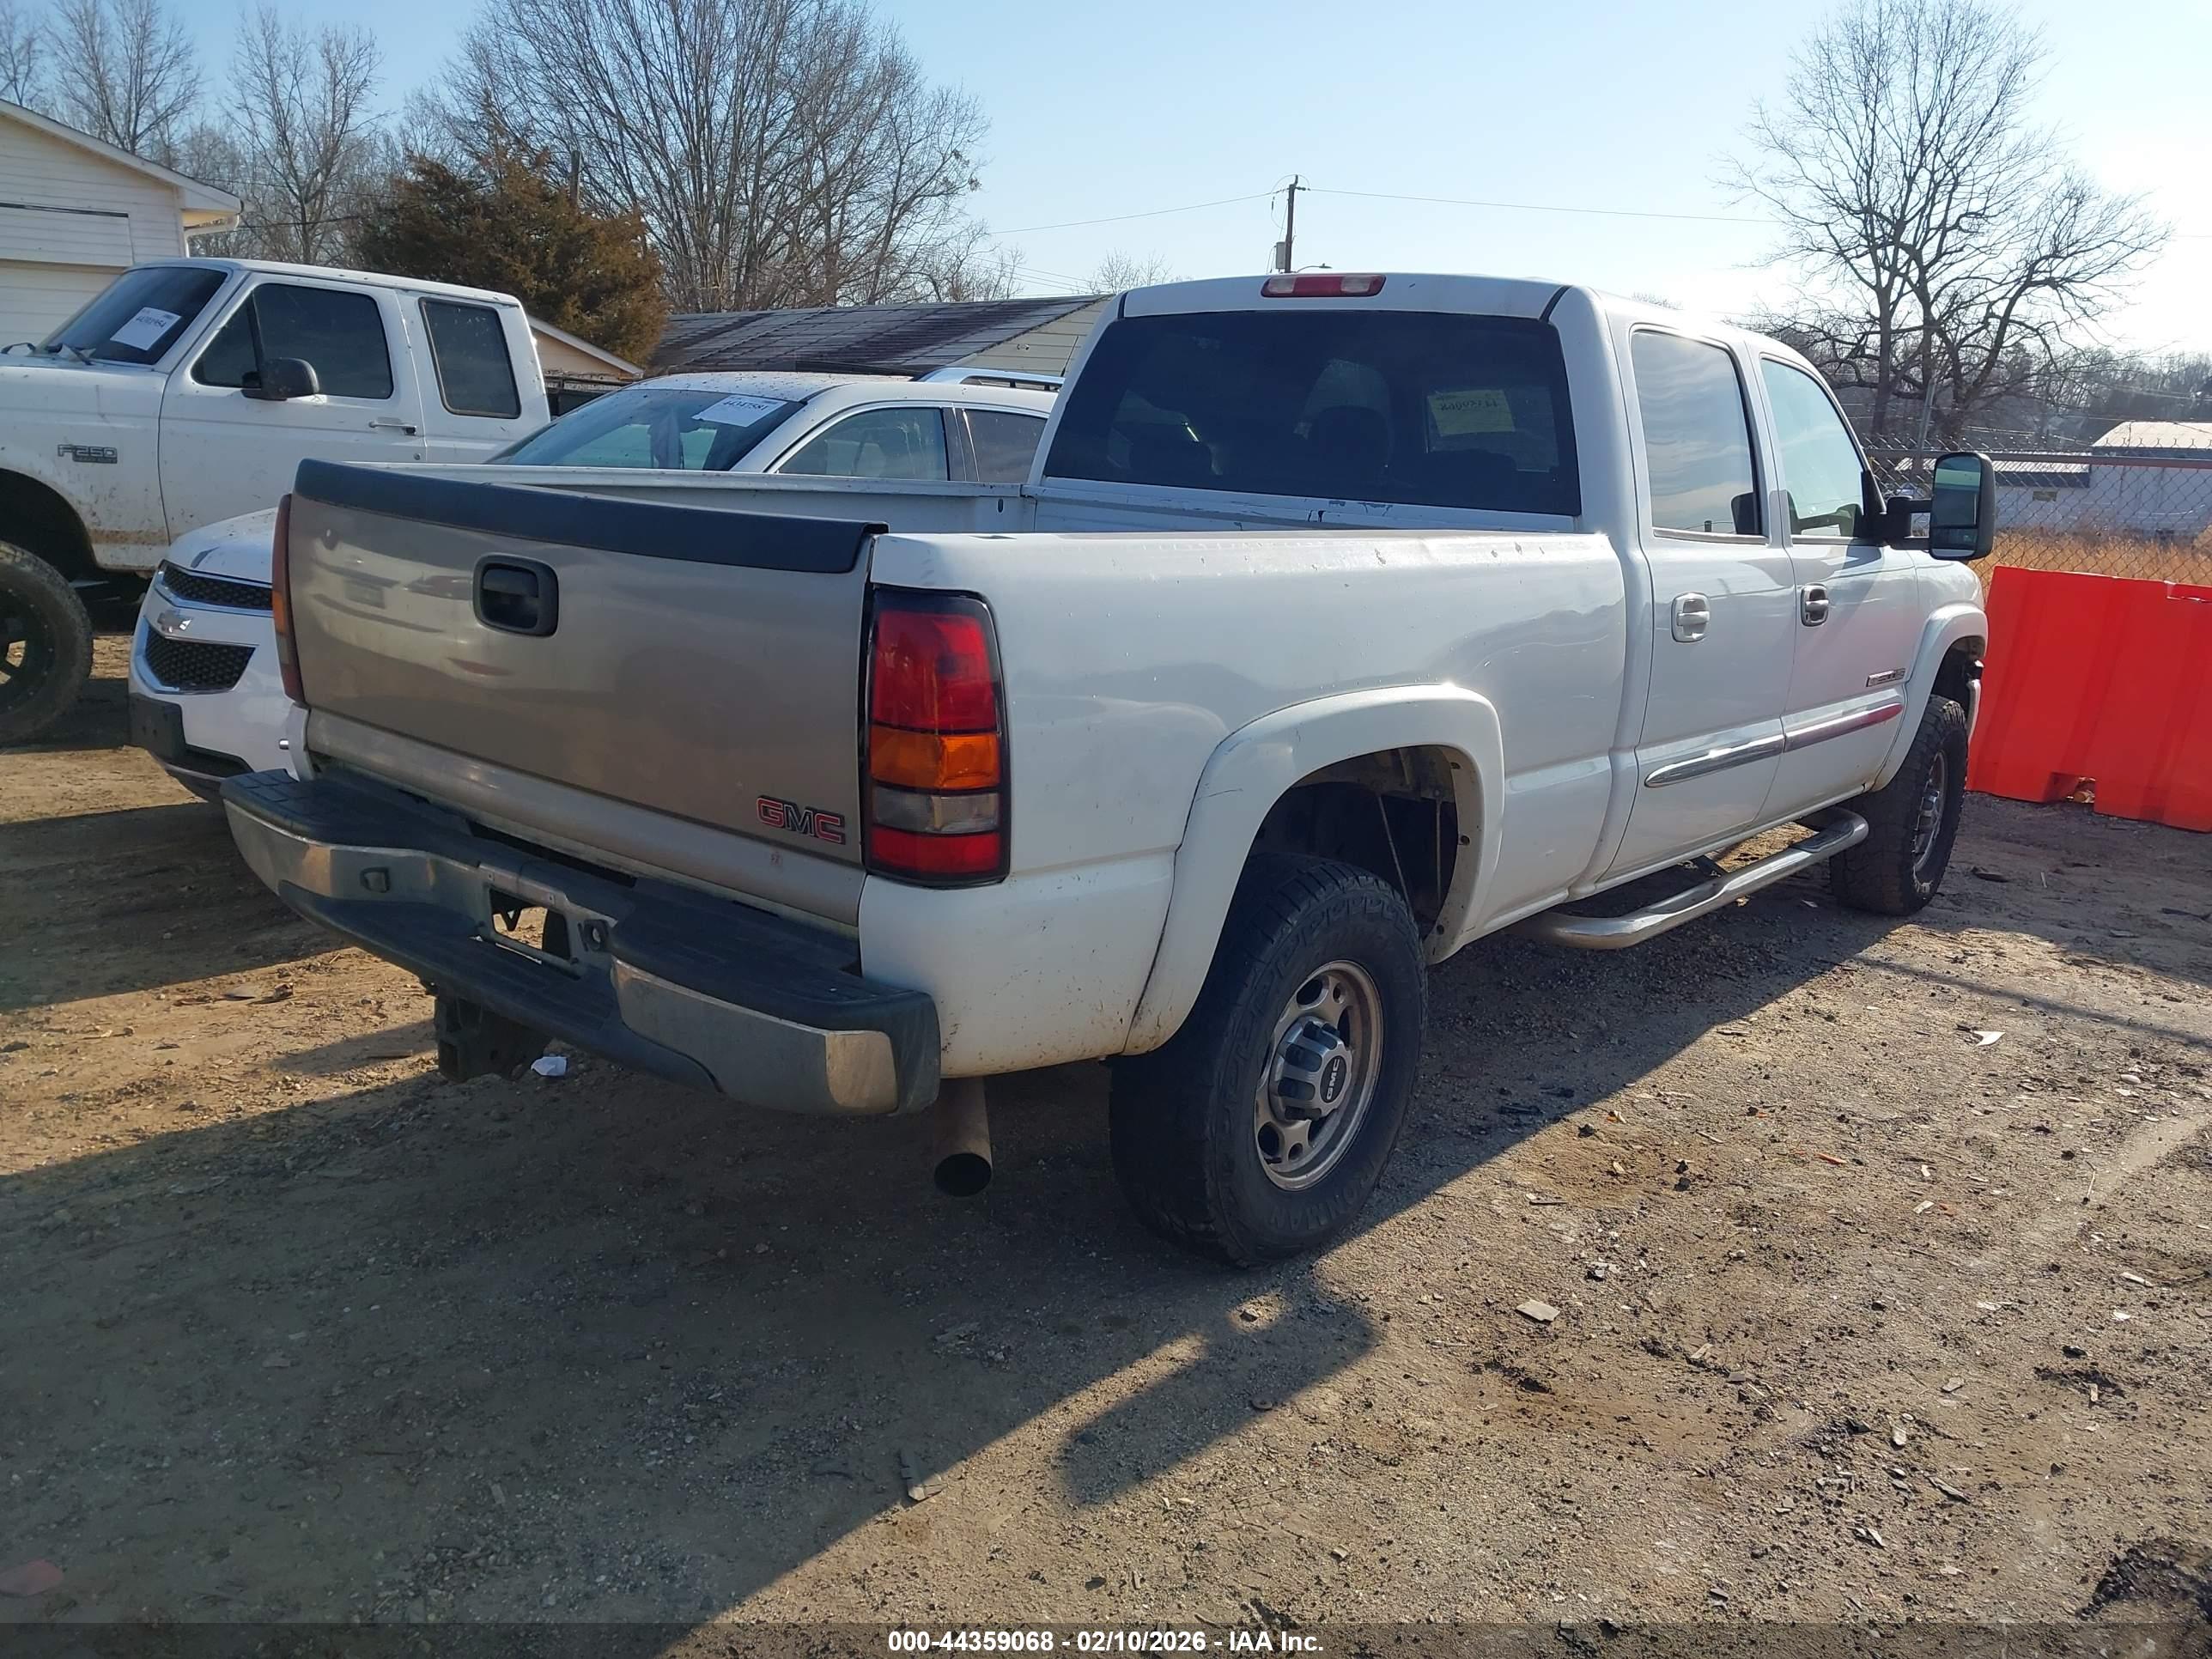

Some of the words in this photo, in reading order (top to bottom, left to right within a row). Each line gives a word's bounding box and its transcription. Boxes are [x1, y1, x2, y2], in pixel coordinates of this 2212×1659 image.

[57, 444, 118, 459] F250
[757, 796, 846, 845] GMC
[1326, 1058, 1340, 1100] GMC
